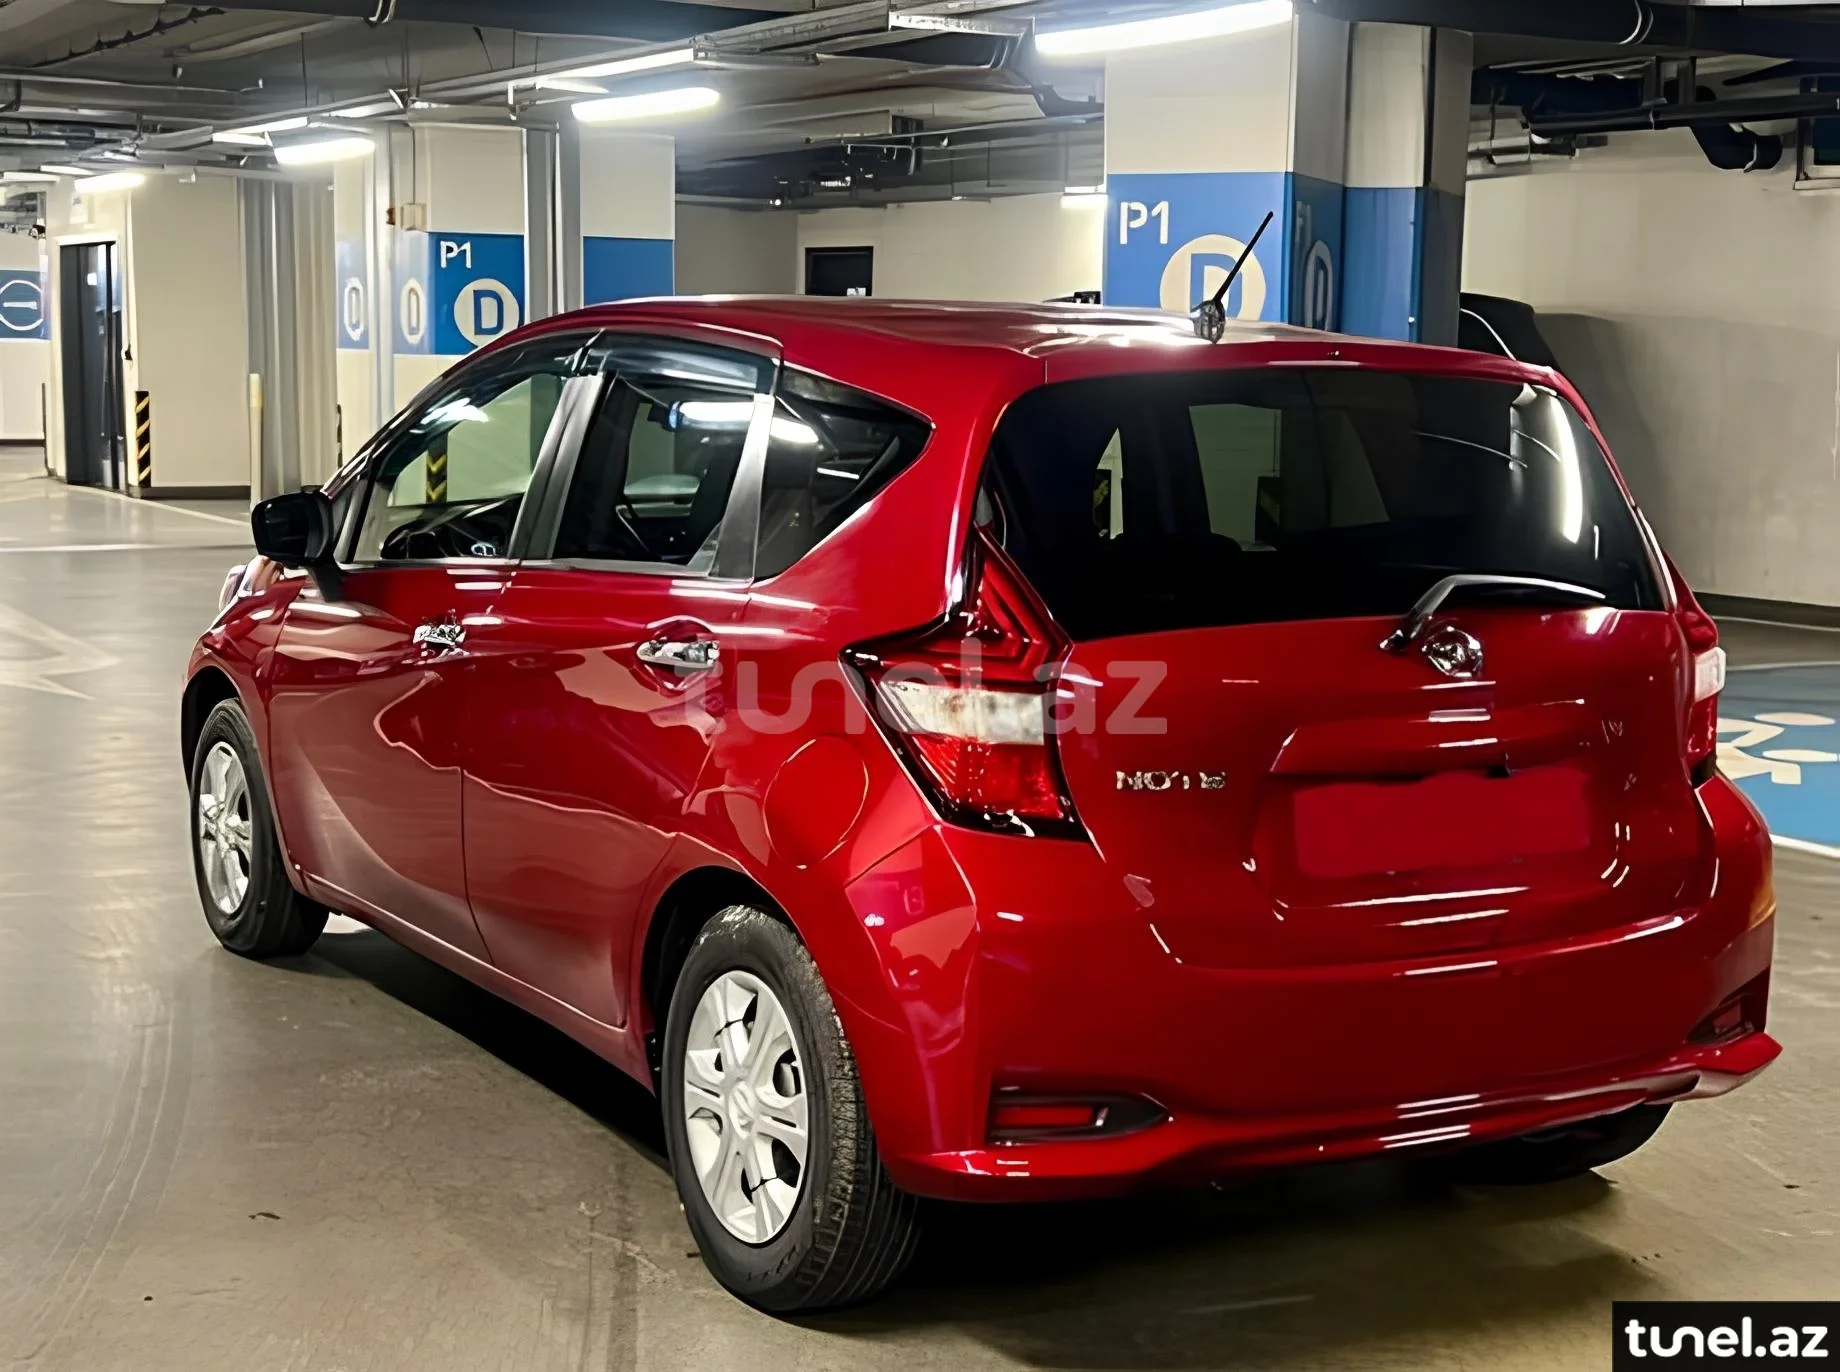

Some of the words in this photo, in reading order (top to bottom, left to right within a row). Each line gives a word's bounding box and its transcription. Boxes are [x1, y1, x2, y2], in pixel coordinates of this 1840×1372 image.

[1119, 200, 1169, 245] P1
[440, 240, 472, 269] P1
[473, 289, 504, 336] D
